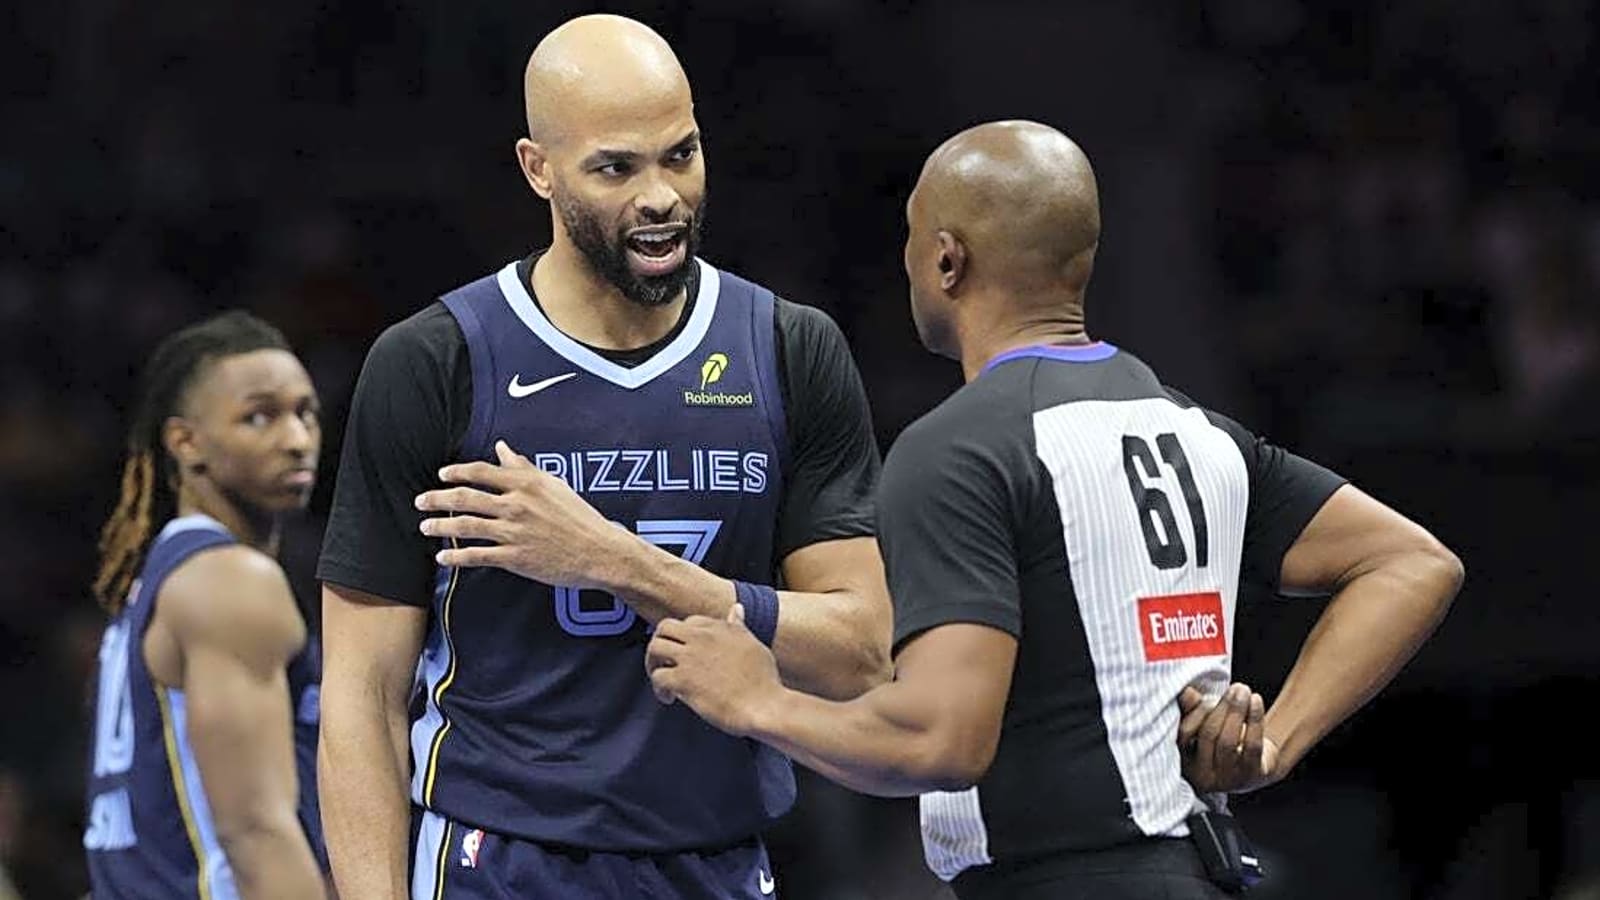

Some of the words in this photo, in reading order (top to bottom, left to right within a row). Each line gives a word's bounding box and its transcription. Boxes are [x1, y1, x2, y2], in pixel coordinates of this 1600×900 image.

[684, 391, 753, 404] Robinhood
[535, 449, 768, 494] RIZZLIES
[1121, 432, 1209, 570] 61
[1148, 608, 1218, 644] Emirates
